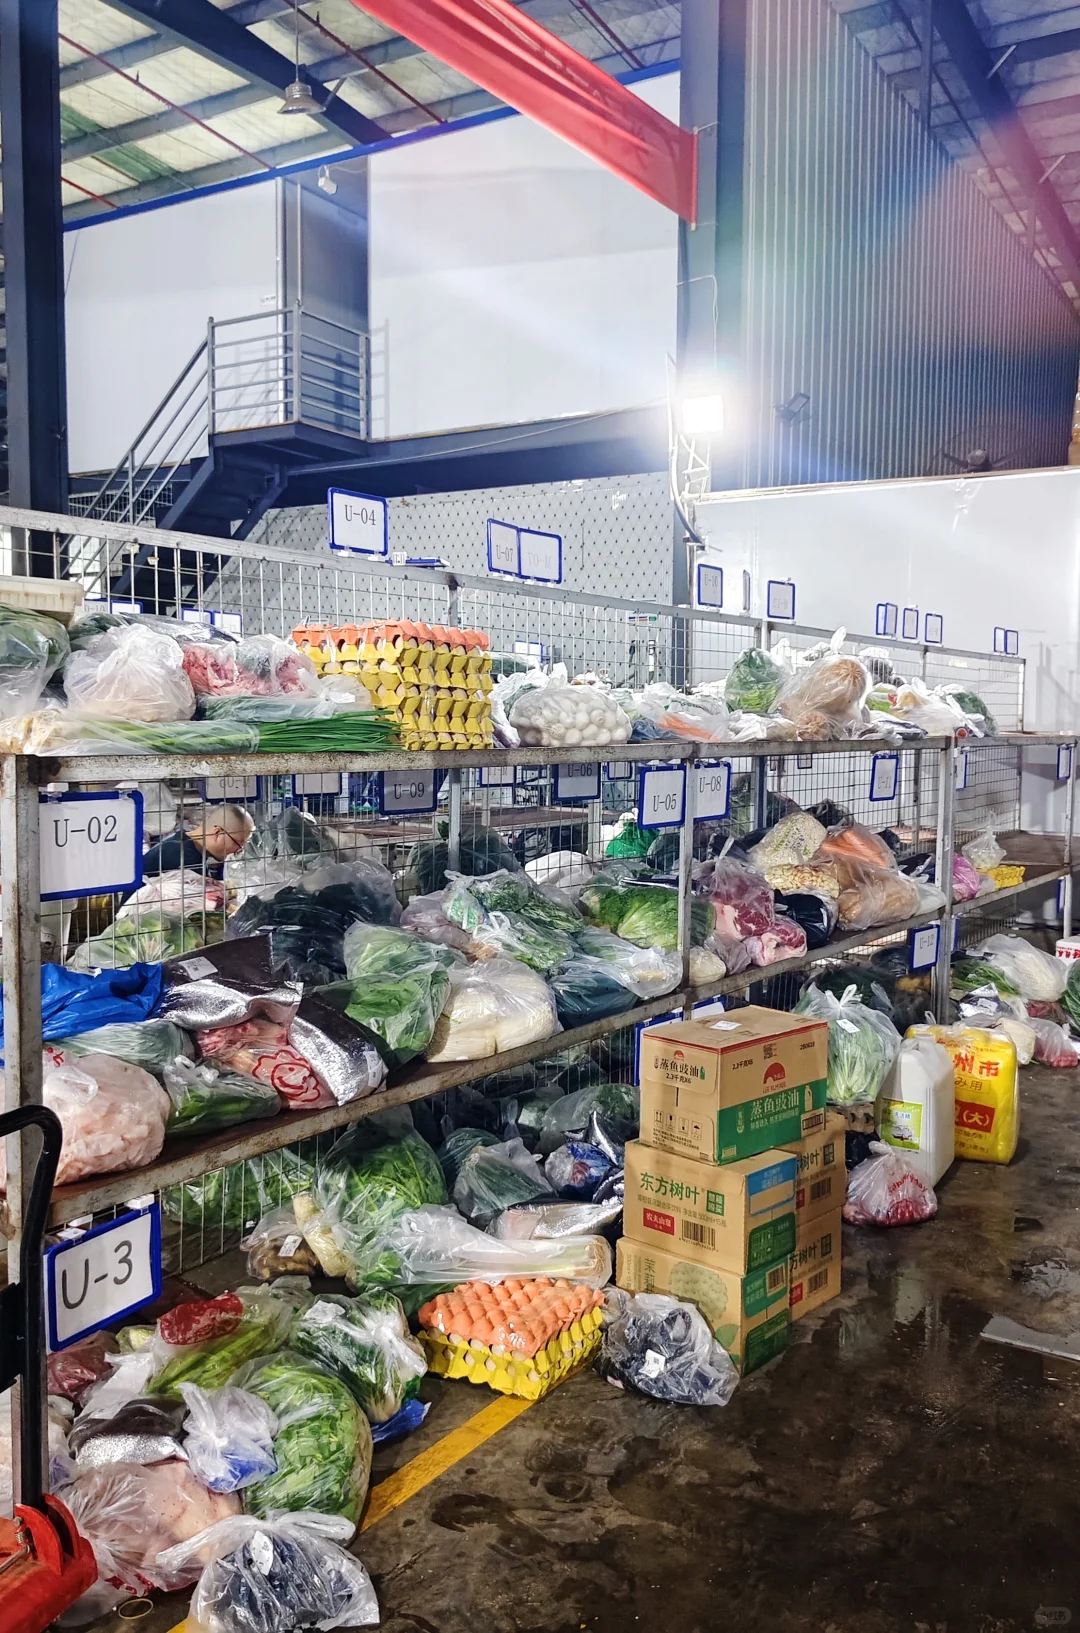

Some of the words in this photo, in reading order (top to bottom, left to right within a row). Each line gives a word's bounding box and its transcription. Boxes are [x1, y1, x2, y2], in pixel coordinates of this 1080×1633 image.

[344, 504, 376, 526] U-04
[394, 782, 425, 800] U-09
[699, 776, 722, 793] U-08
[653, 793, 677, 812] U-05
[53, 815, 118, 848] U-02
[659, 1058, 699, 1078] 蒸鱼豉油
[750, 1088, 800, 1121] 蒸鱼豉油
[640, 1171, 700, 1205] 东方树叶
[61, 1239, 133, 1310] U-3
